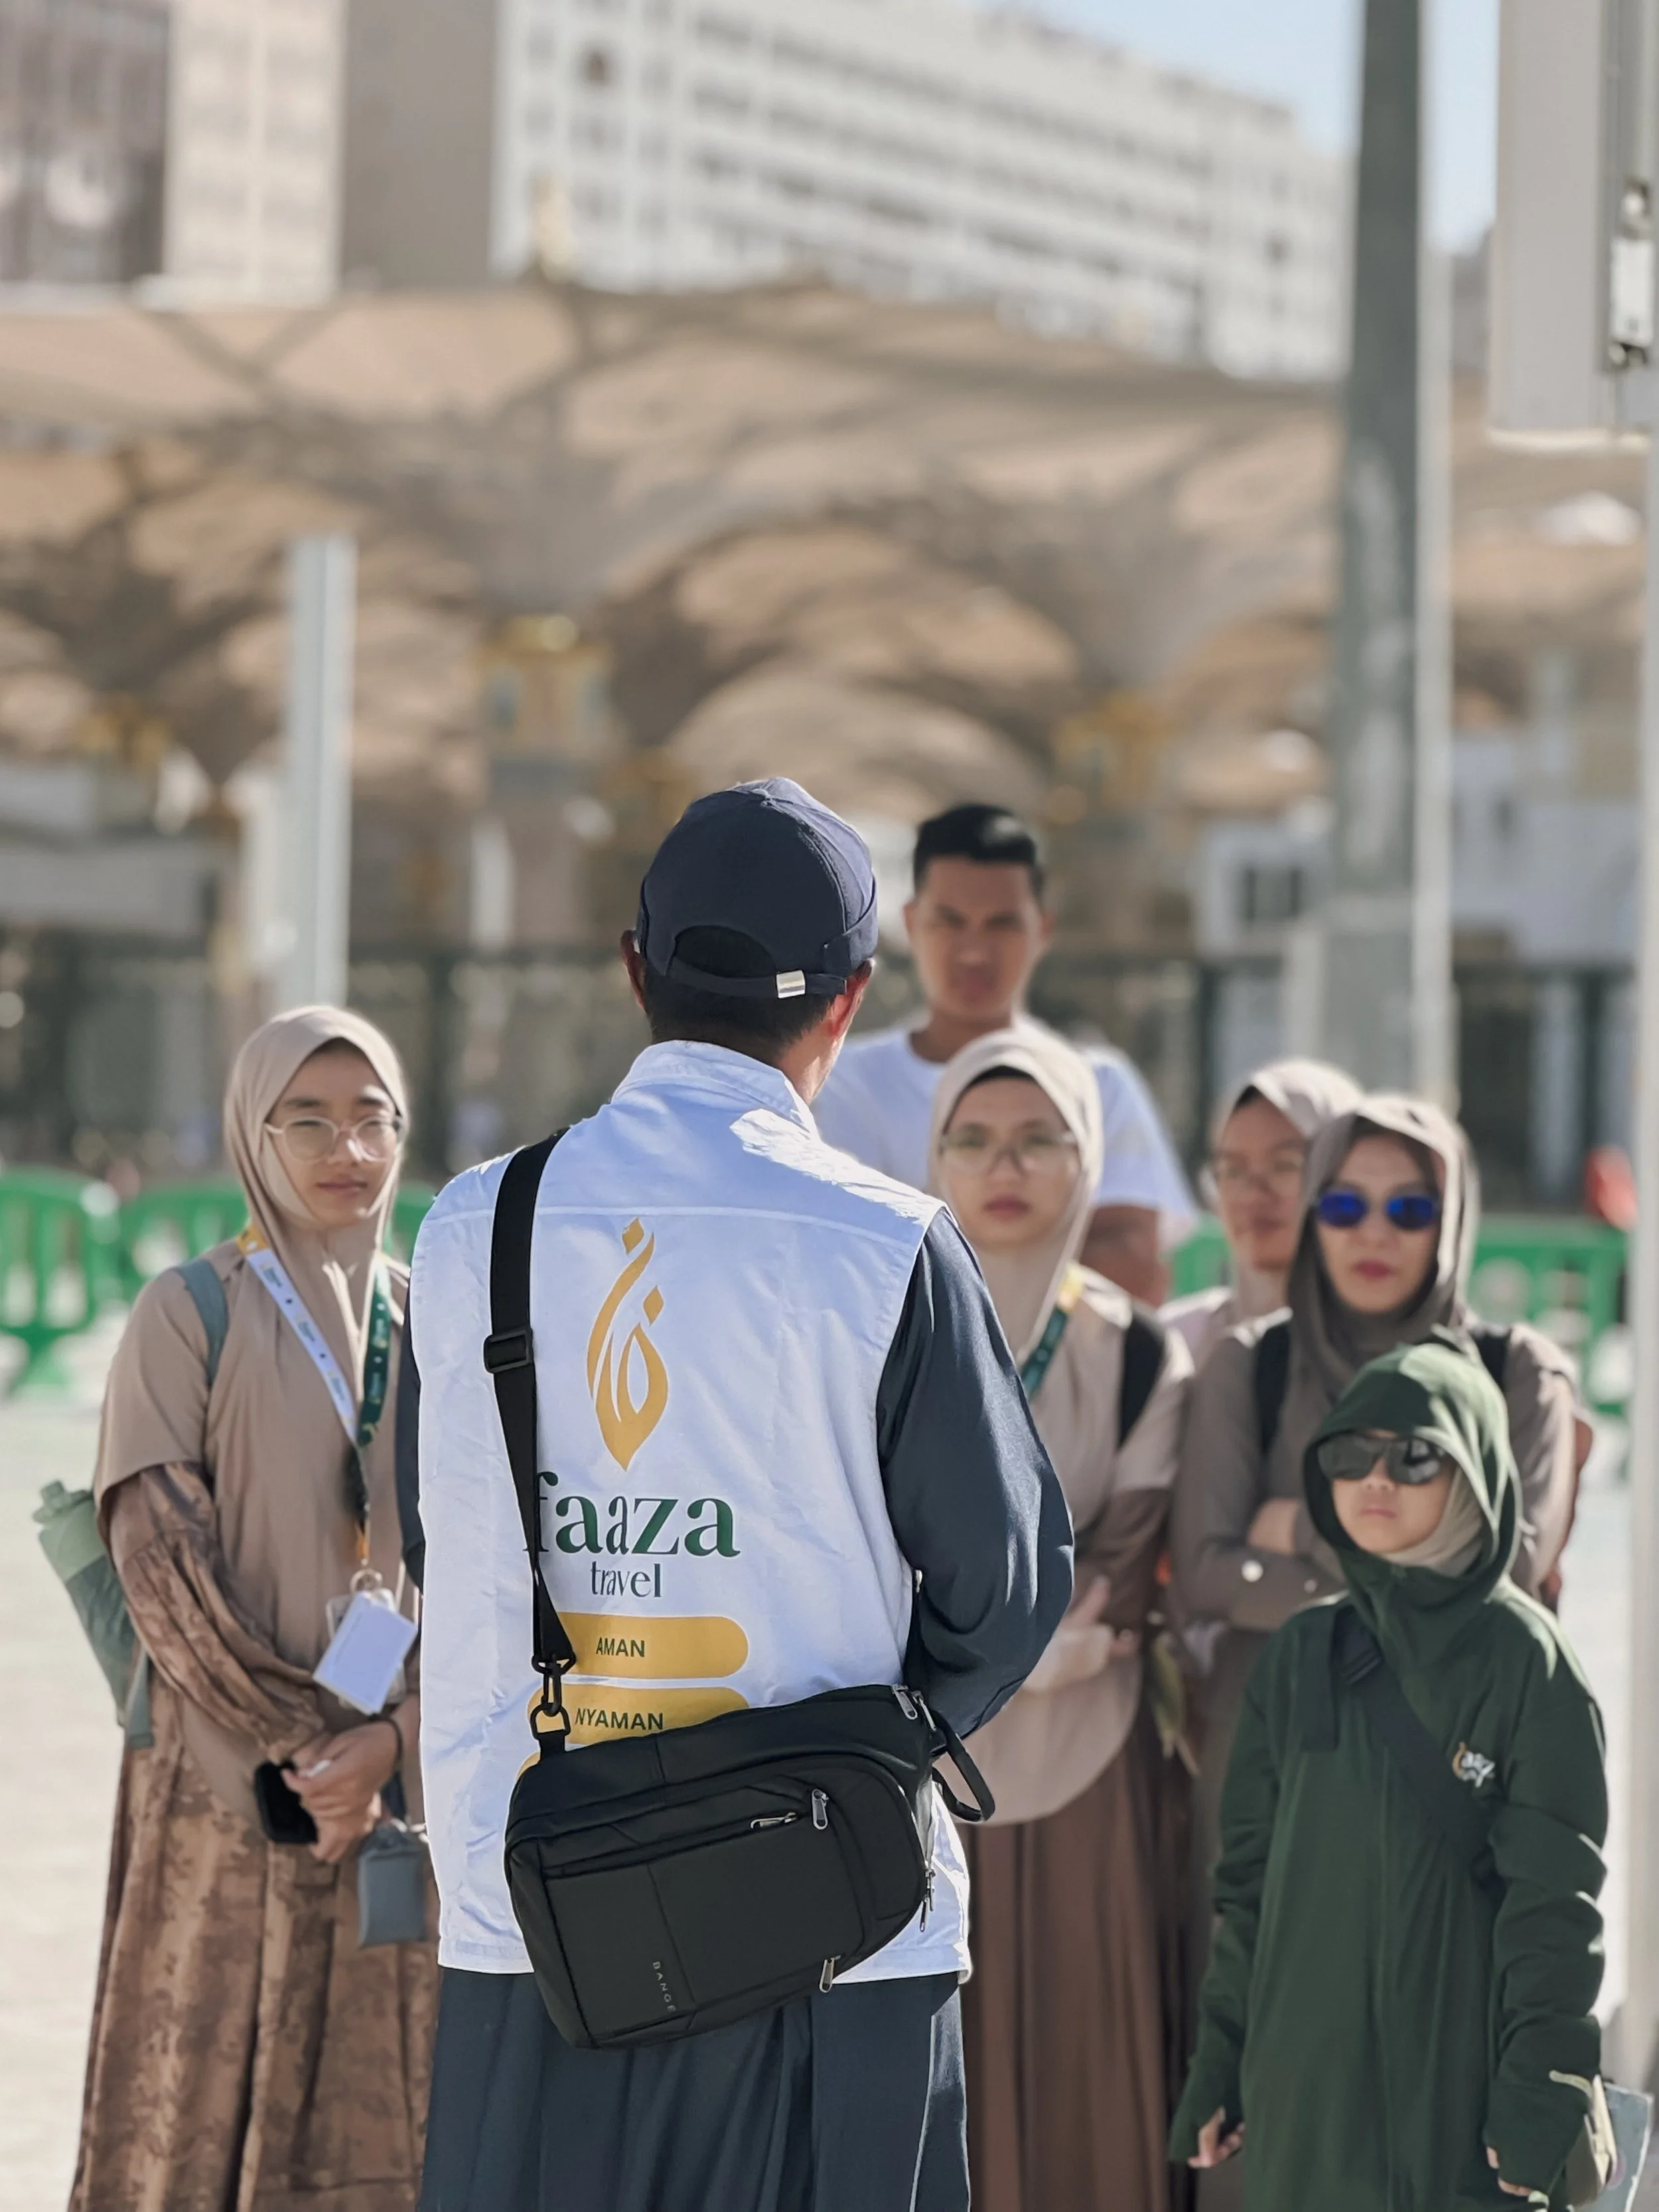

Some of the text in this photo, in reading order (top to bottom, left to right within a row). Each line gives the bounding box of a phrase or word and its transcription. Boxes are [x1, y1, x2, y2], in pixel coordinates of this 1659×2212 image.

[590, 1561, 662, 1598] travel
[596, 1637, 645, 1657] AMAN
[575, 1708, 664, 1730] NYAMAN
